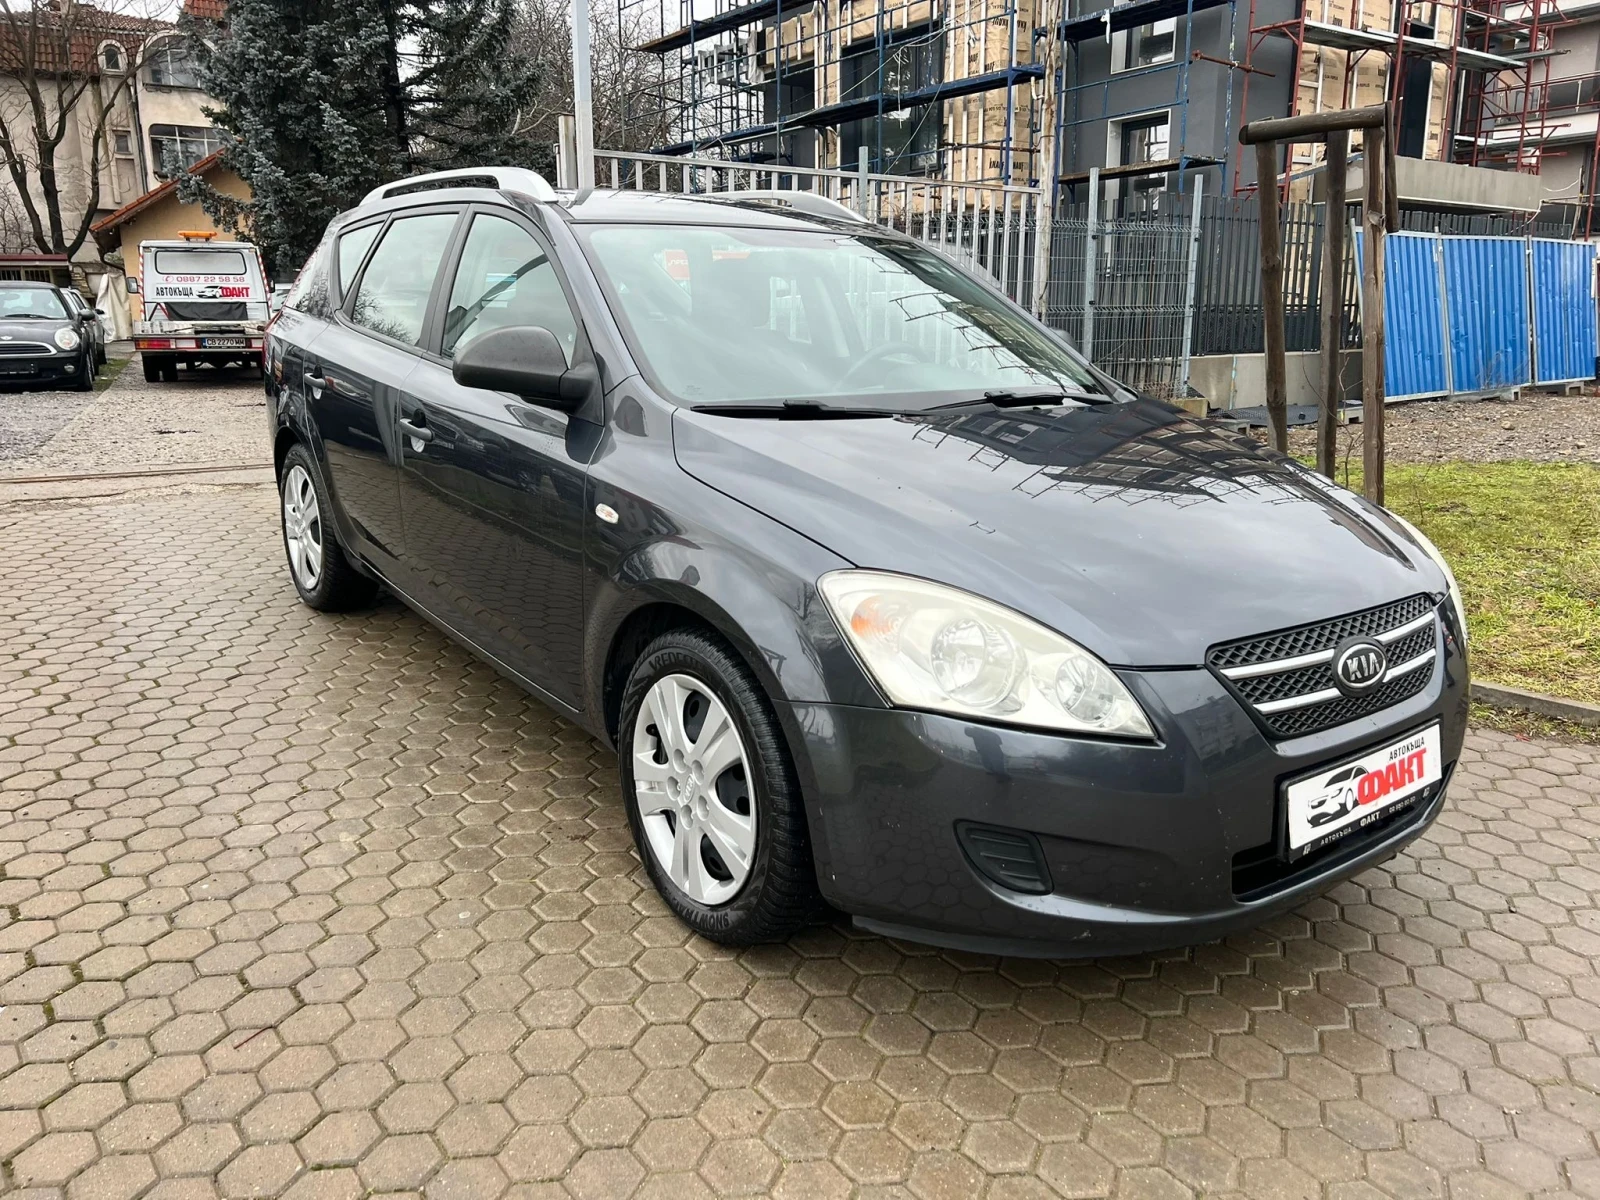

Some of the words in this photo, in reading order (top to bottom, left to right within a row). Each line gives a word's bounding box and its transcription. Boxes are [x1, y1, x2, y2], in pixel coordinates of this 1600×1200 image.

[155, 286, 194, 297] АВТОКЪЩА
[217, 338, 234, 346] 2270
[1346, 652, 1380, 681] KIA
[1389, 736, 1425, 761] АВТОКЪЩА
[1358, 747, 1427, 805] ФАКТ
[1360, 811, 1381, 827] ФАКТ
